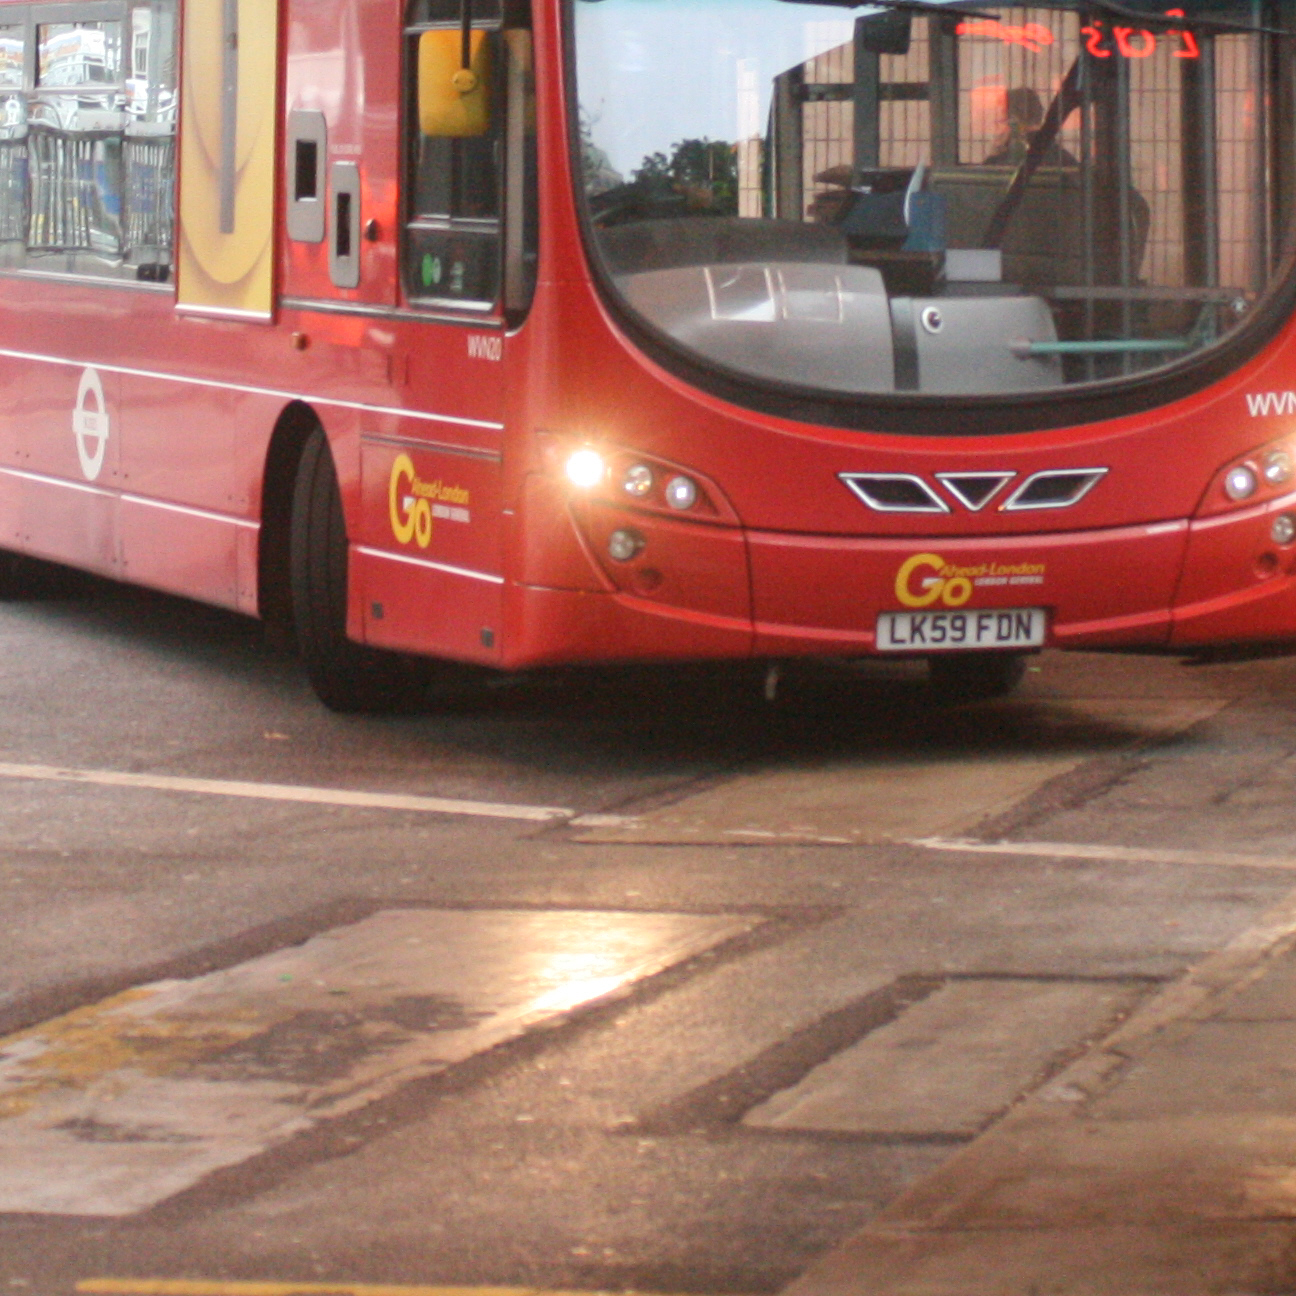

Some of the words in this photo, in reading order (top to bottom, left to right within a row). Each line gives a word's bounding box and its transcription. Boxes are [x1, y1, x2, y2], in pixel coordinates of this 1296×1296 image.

[389, 453, 432, 549] Go
[895, 553, 973, 607] Go
[890, 615, 967, 644] LK59
[976, 613, 1032, 642] FDN
